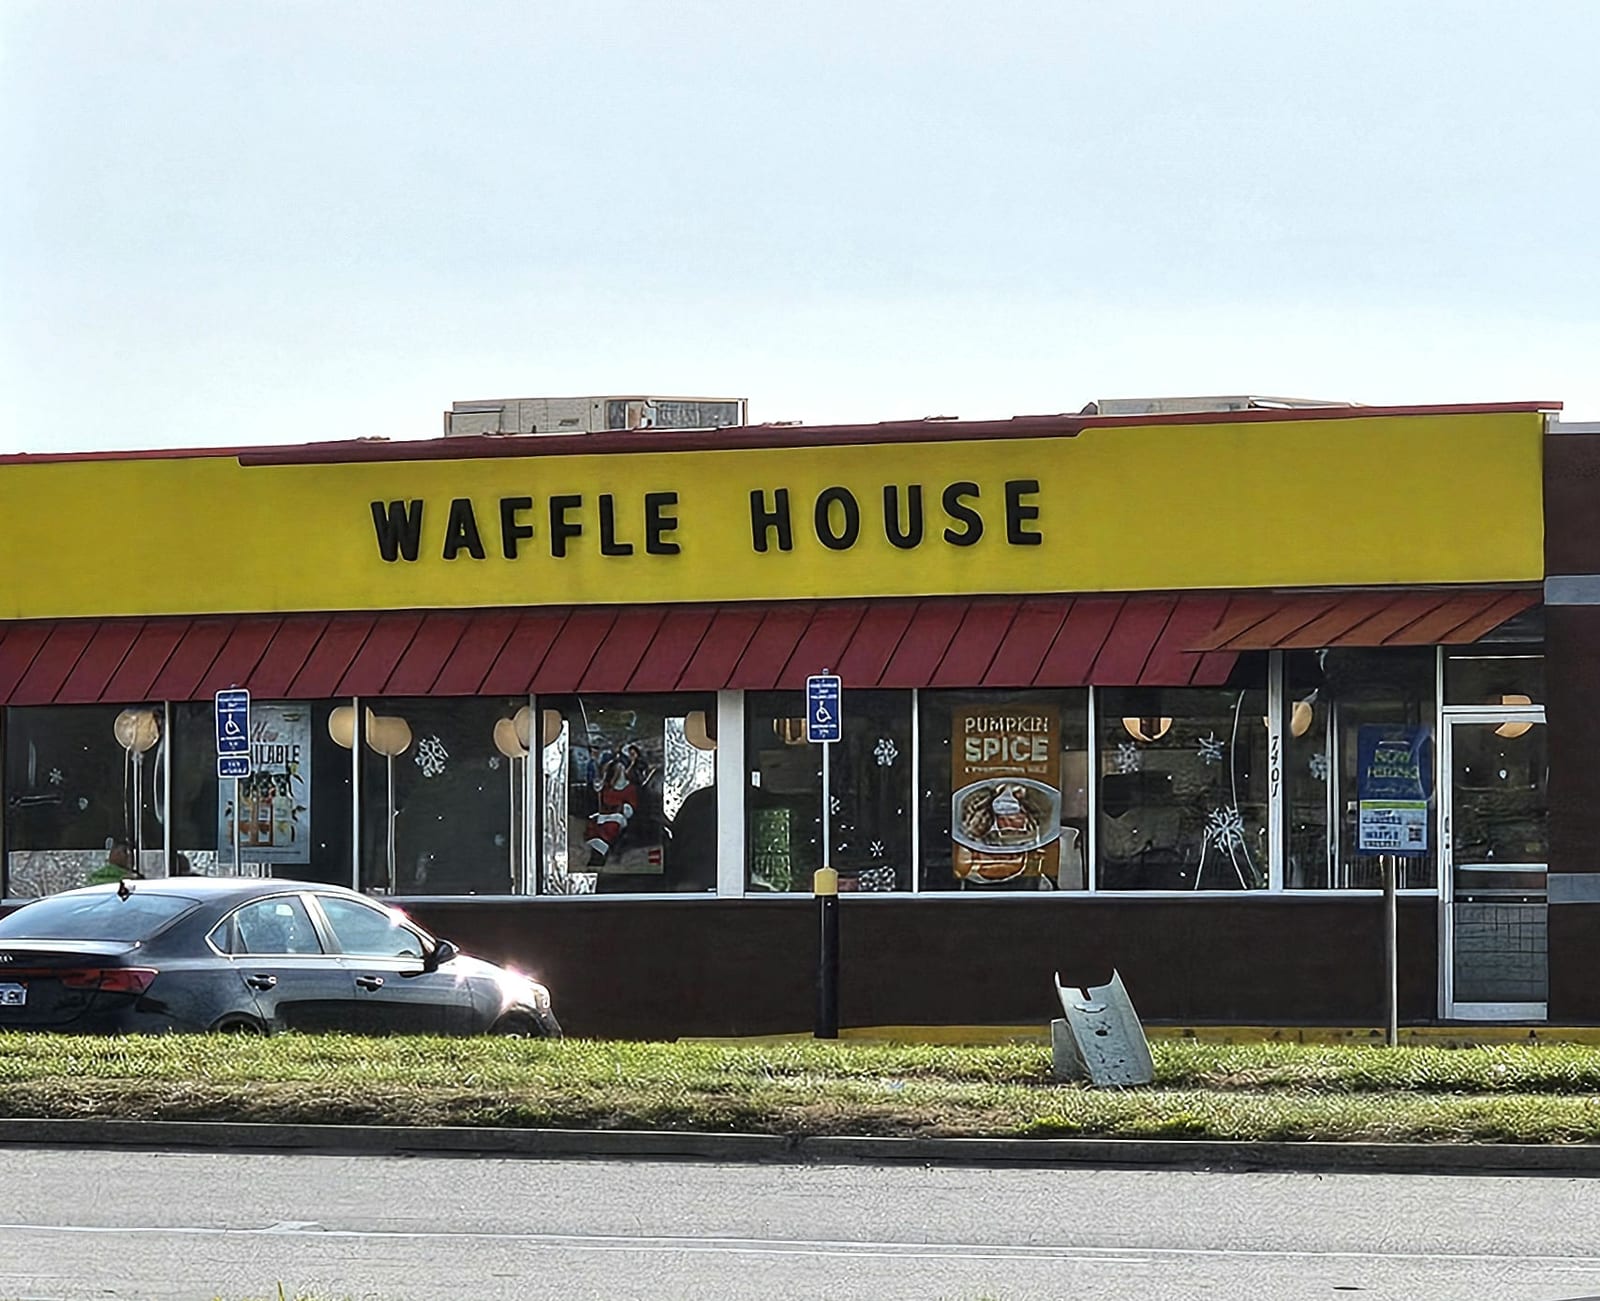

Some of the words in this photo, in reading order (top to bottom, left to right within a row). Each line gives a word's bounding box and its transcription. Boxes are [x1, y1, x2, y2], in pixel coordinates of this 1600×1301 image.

[370, 491, 681, 563] WAFFLE
[750, 479, 1043, 553] HOUSE
[964, 716, 1049, 733] PUMPKIN
[964, 736, 1049, 761] SPICE
